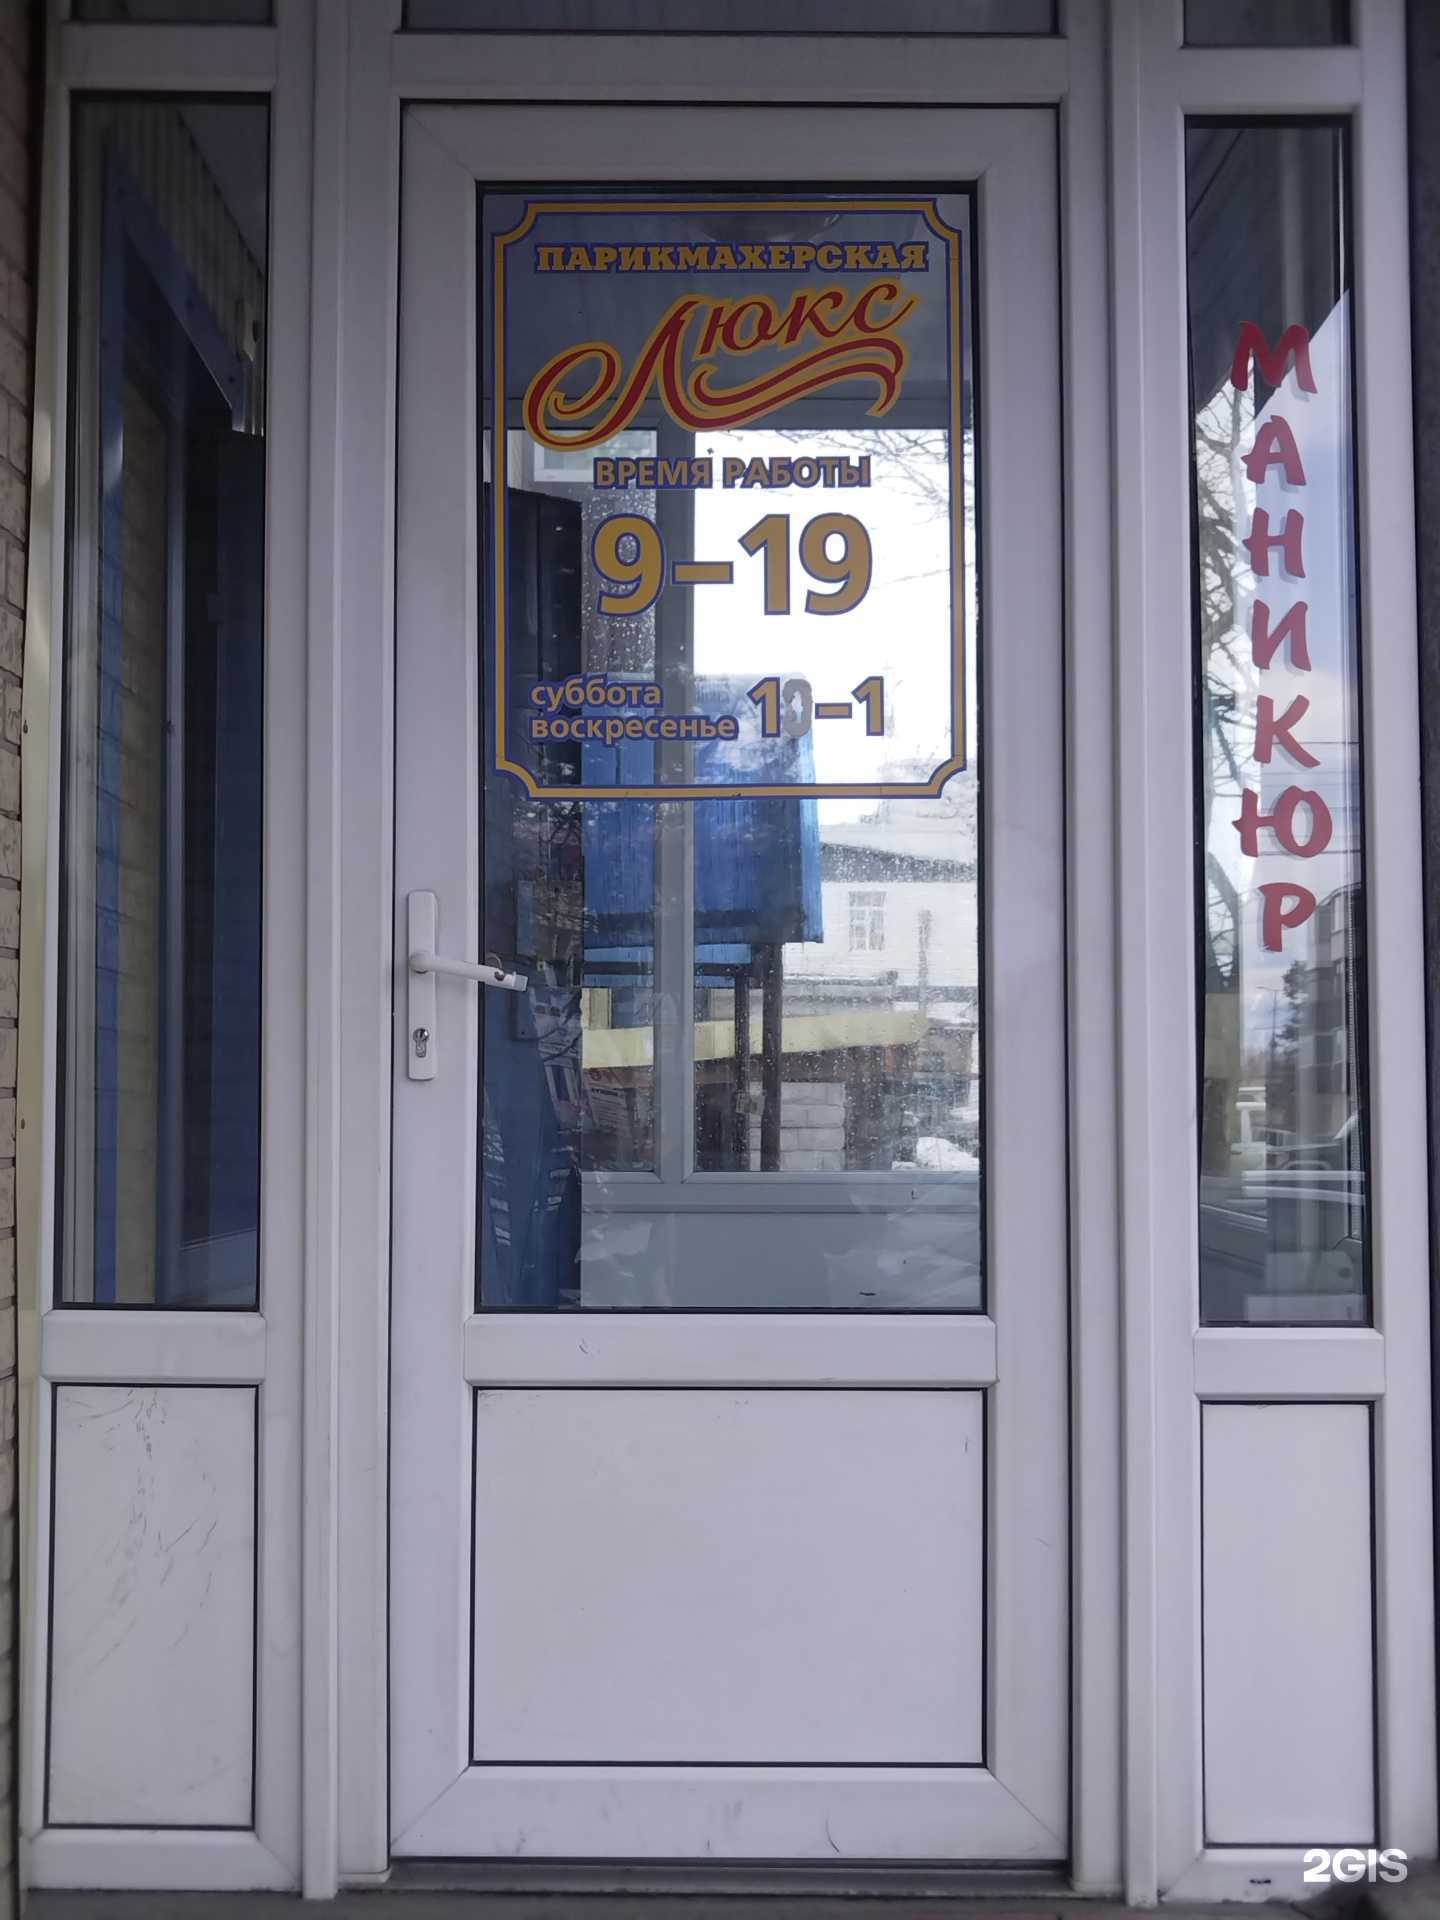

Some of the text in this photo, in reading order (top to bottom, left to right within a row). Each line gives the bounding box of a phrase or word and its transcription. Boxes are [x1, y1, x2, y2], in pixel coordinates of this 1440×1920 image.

[534, 241, 929, 272] ПАРИКМАХЕРСКАЯ
[523, 277, 920, 452] Люкс
[593, 456, 872, 489] ВРЕМЯ РАБОТЫ
[591, 512, 873, 616] 9-19
[1230, 321, 1333, 952] МАНИКЮР
[530, 672, 664, 712] суббота
[530, 715, 740, 747] воскресенье
